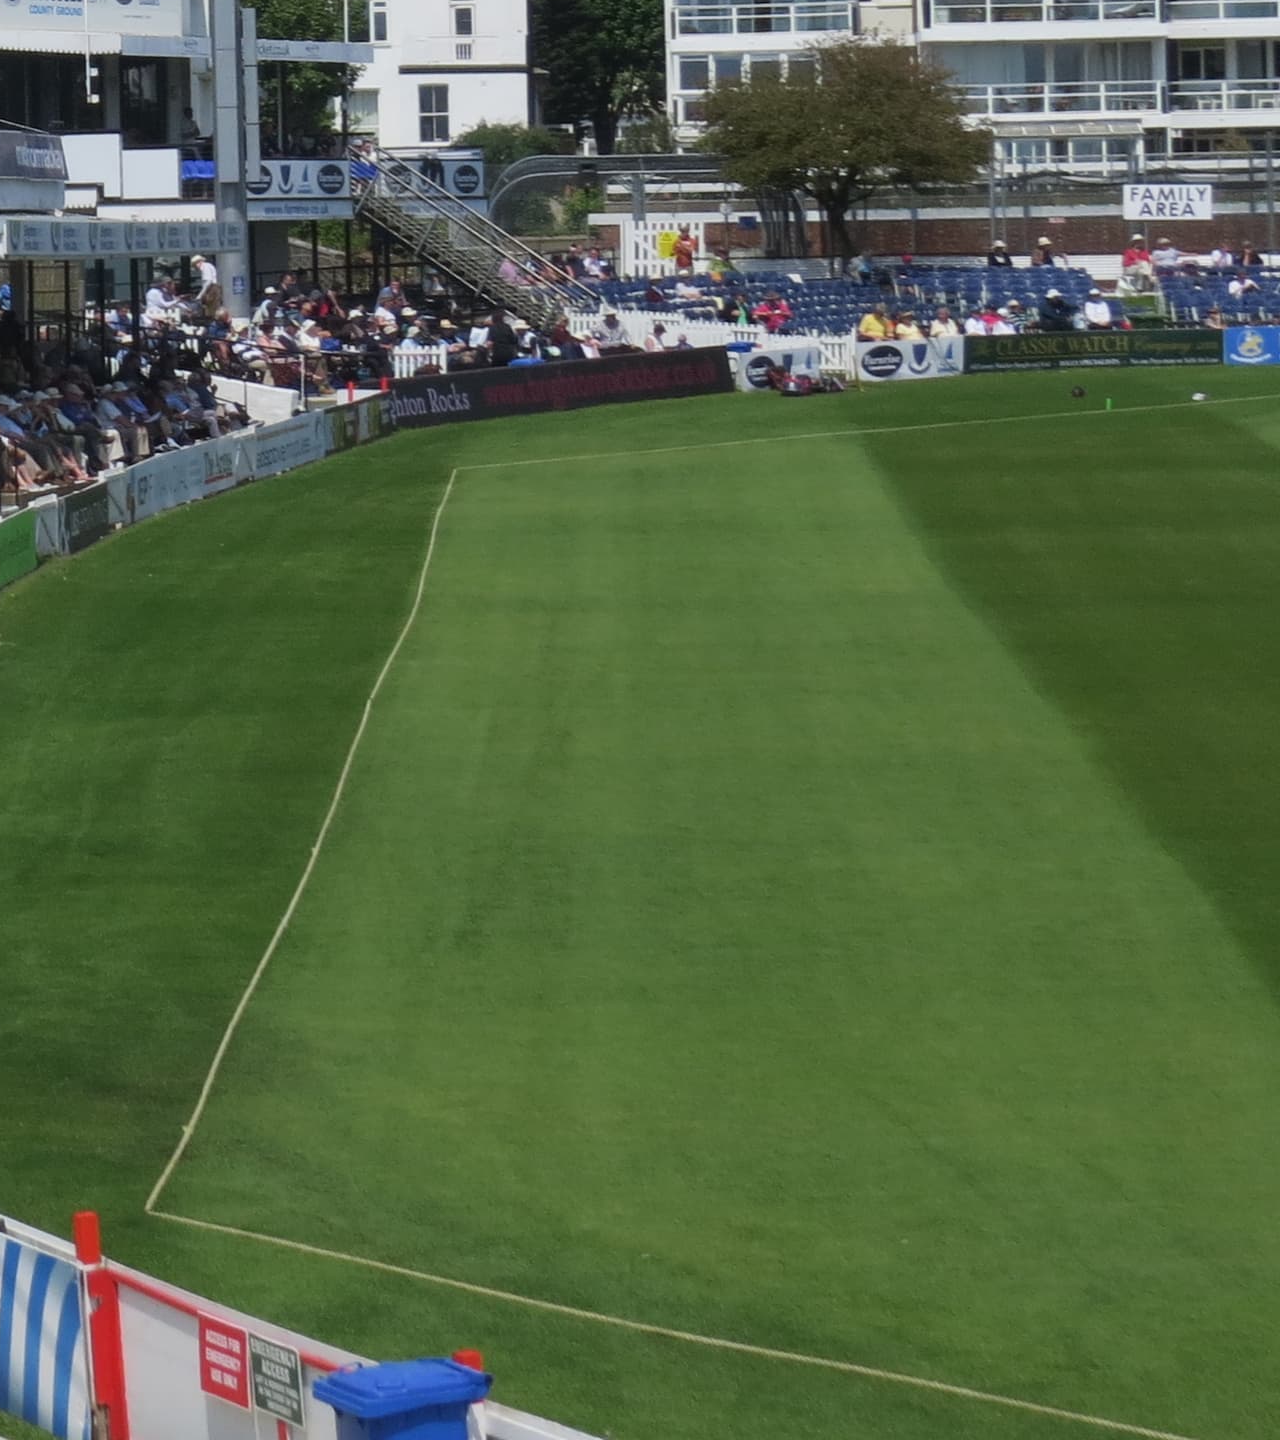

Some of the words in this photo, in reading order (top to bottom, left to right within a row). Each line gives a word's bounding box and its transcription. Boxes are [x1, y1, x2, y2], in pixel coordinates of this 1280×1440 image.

[30, 5, 54, 15] COUNTY
[1130, 185, 1209, 203] FAMILY
[1140, 201, 1197, 218] AREA
[996, 337, 1063, 357] CLASSIC
[1067, 335, 1130, 355] WATCH
[426, 383, 471, 413] Rocks
[249, 1336, 296, 1370] EMERGENCY
[261, 1358, 290, 1385] ACCESS
